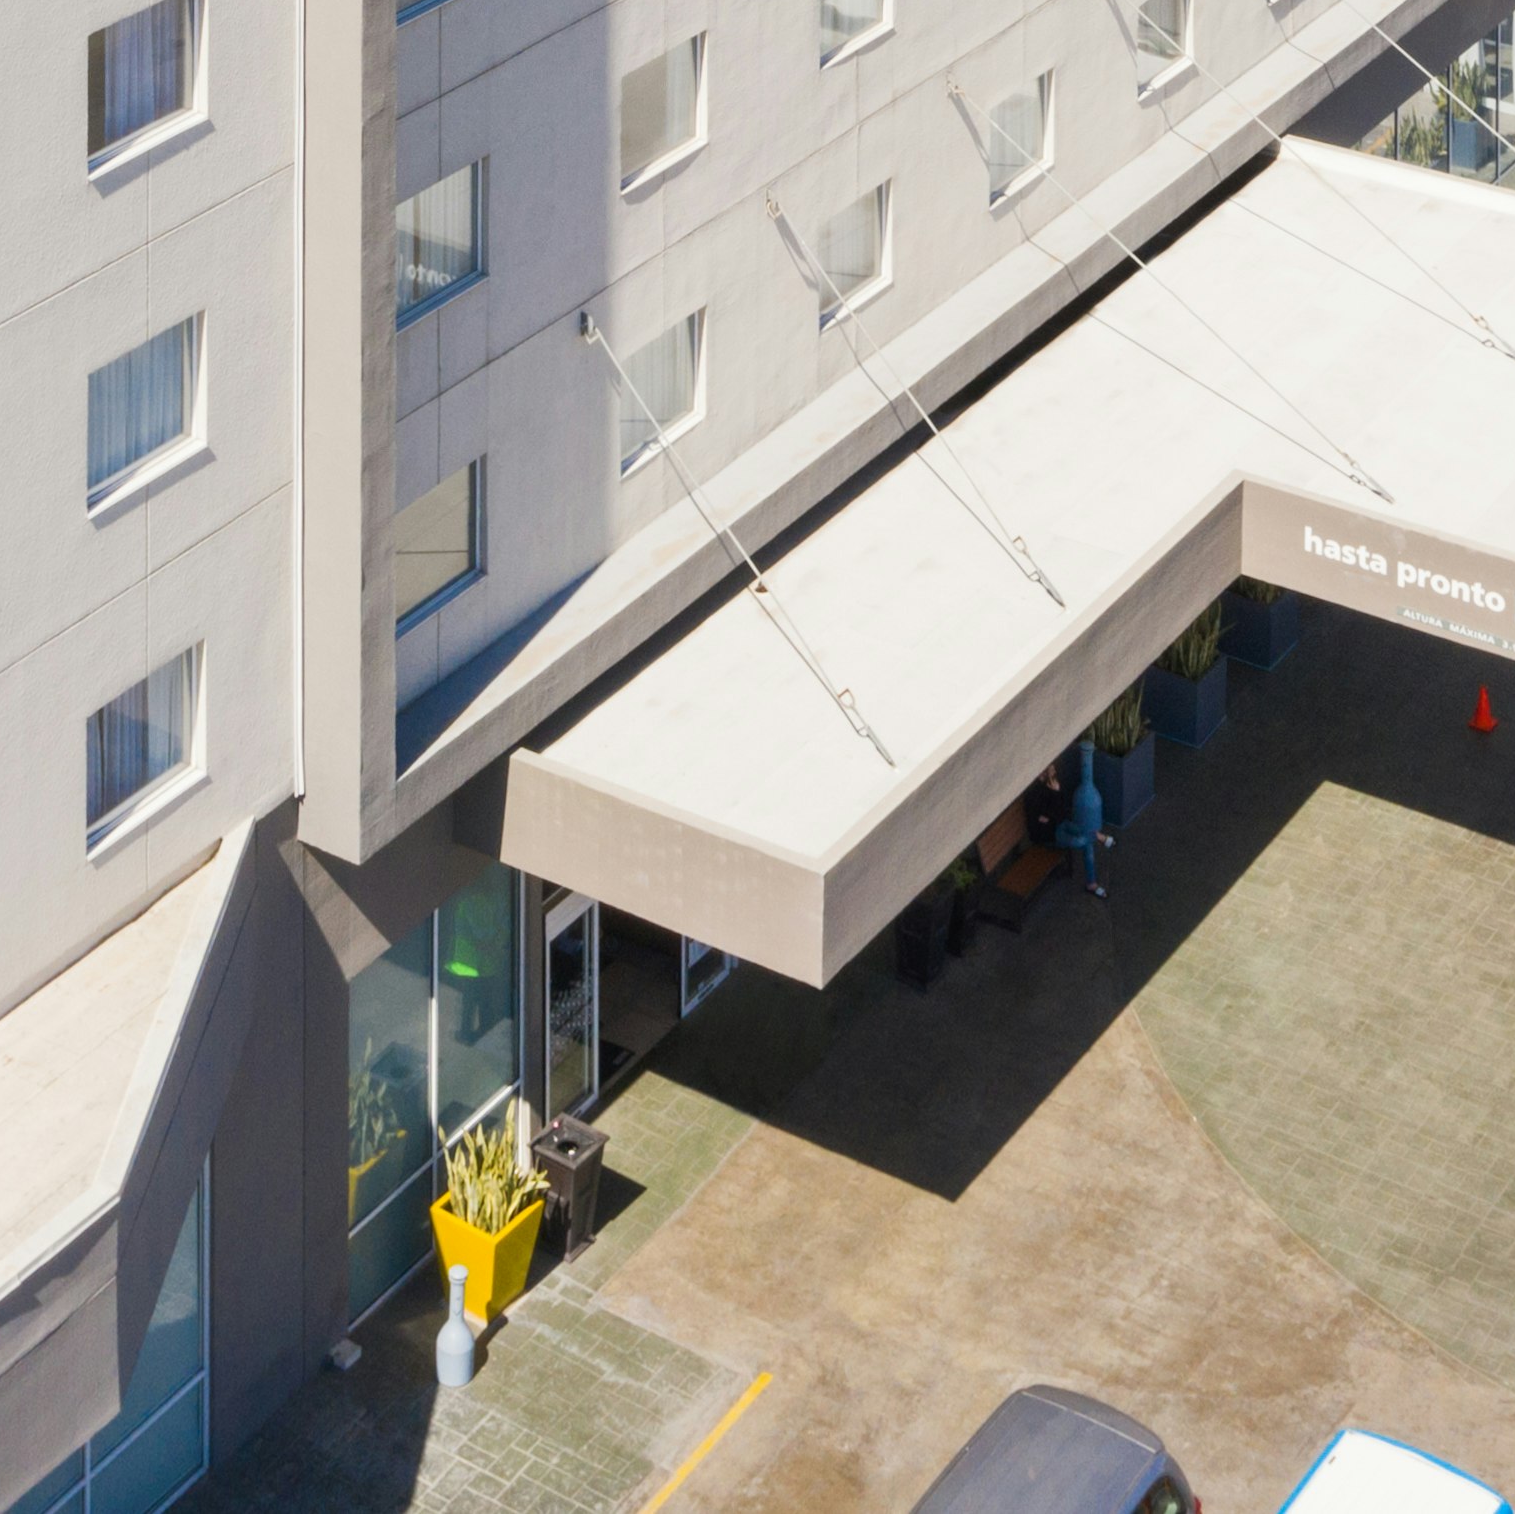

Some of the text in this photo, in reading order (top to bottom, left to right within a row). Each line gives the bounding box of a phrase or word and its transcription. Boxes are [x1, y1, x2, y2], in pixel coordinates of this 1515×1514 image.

[1303, 525, 1388, 576] hasta
[1396, 560, 1506, 613] pronto
[1402, 608, 1444, 629] ALTURA
